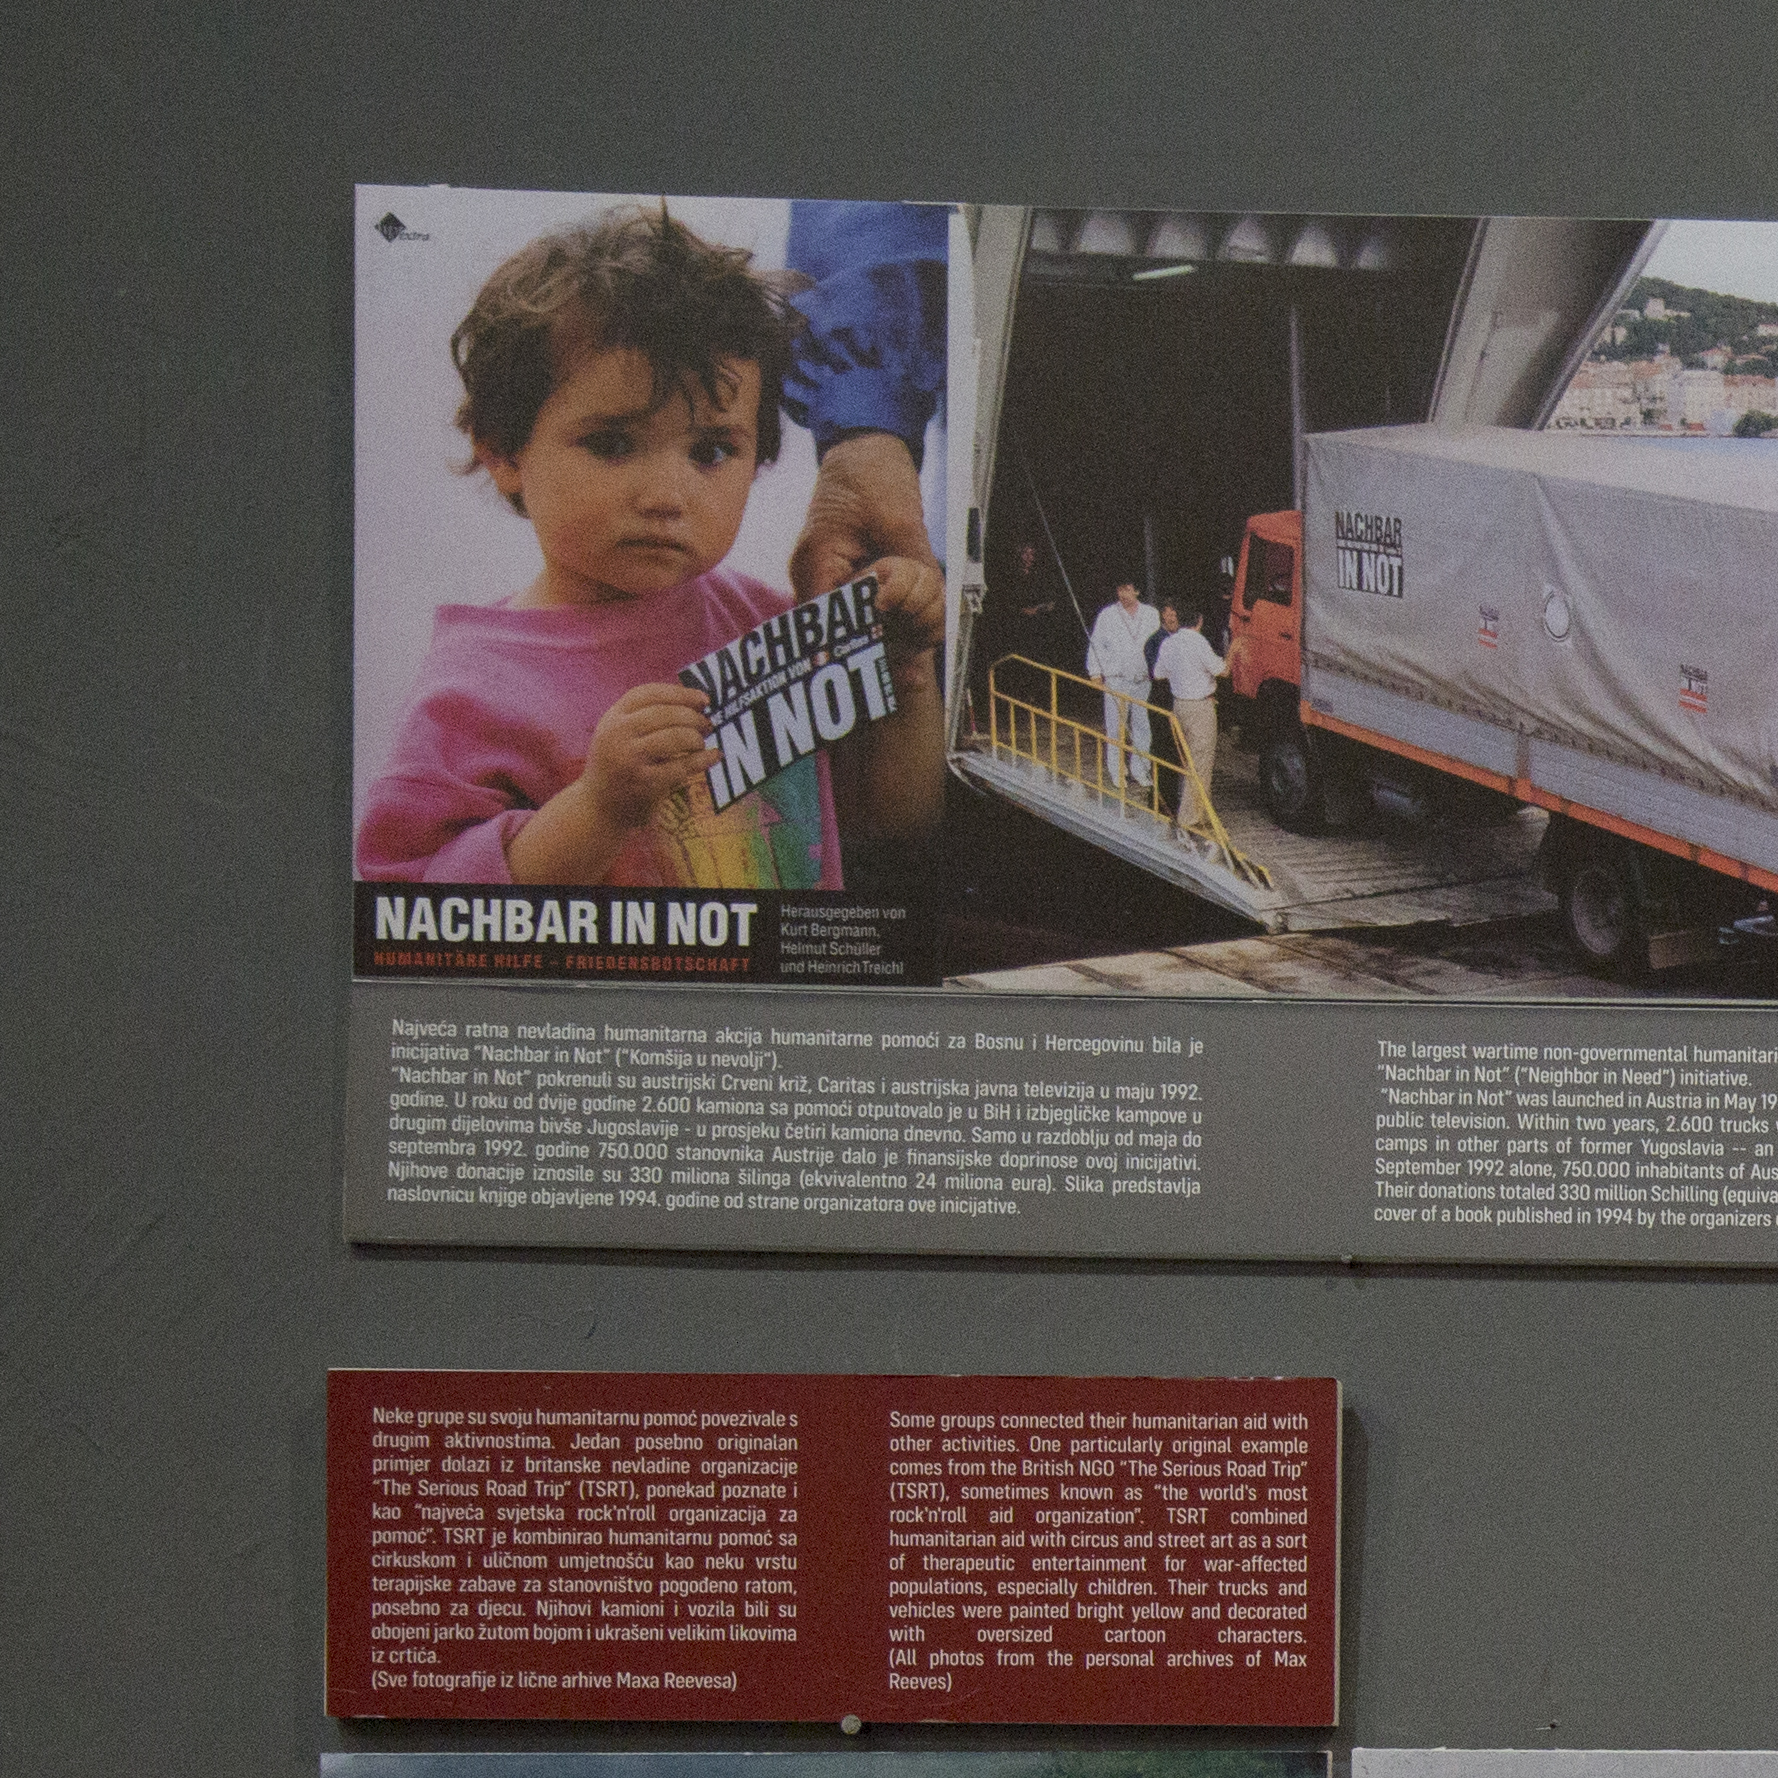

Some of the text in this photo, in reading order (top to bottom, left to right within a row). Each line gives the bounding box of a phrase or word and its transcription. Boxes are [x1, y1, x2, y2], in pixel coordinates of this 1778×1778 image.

[1335, 511, 1402, 546] NACHBAR
[1337, 549, 1402, 597] IN NOT
[677, 575, 880, 707] NACHBAR
[704, 709, 767, 810] IN
[767, 642, 887, 768] NOT
[374, 896, 759, 948] NACHBAR IN NOT
[779, 904, 907, 922] Herausgegeben von
[779, 921, 878, 941] Kurt Bergmann,
[779, 939, 882, 957] Helmut Schüller
[373, 950, 750, 973] HUMANITÄRE HILFE FRIEDENSBOTSCHAFT
[780, 960, 905, 977] und Heinrich Treichl
[1377, 1039, 1408, 1059] The
[1410, 1040, 1468, 1063] largest
[1471, 1042, 1539, 1061] wartime
[1542, 1044, 1689, 1066] non-governmental
[372, 1406, 799, 1431] Neke grupe su svoju humanitarnu pomoć povezivale s
